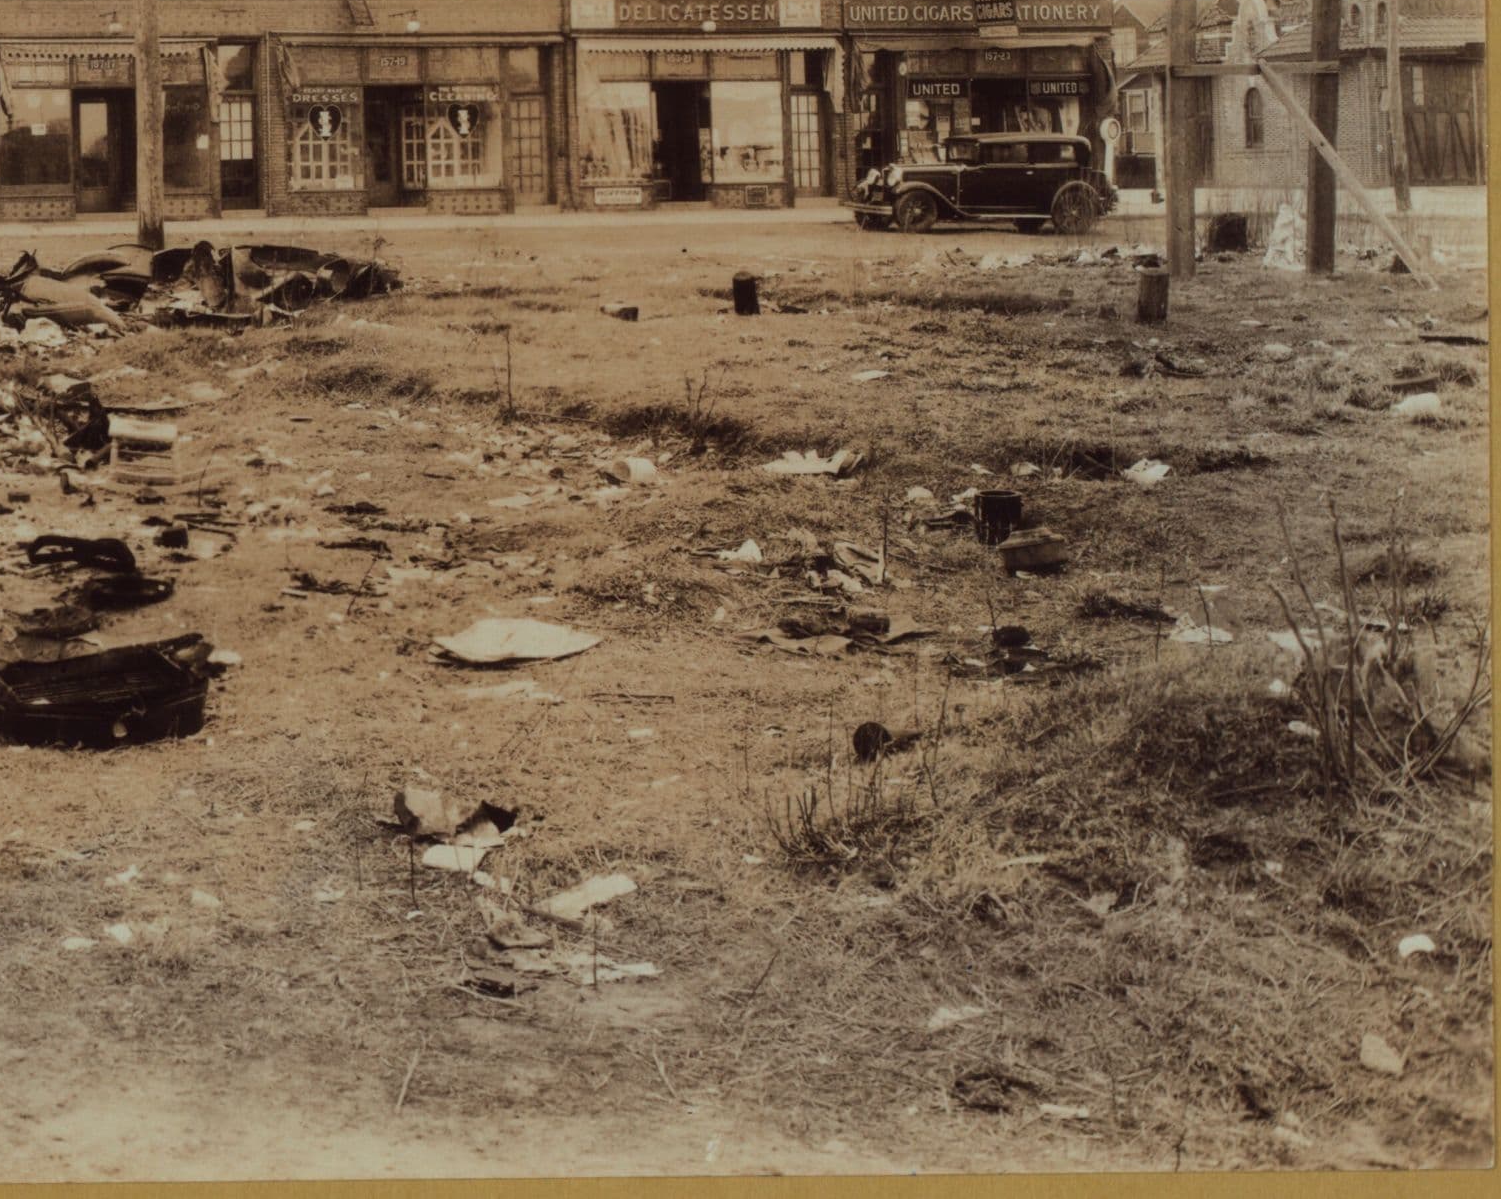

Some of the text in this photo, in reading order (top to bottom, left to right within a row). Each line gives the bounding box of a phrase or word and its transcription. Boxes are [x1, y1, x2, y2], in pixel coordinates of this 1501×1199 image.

[618, 4, 776, 21] DELICATESSEN
[849, 5, 909, 22] UNITED
[912, 5, 974, 22] CIGARS
[976, 2, 1013, 19] CIGARS
[912, 83, 961, 96] UNITED
[1042, 82, 1078, 94] UNITED
[292, 92, 358, 103] DRESSES
